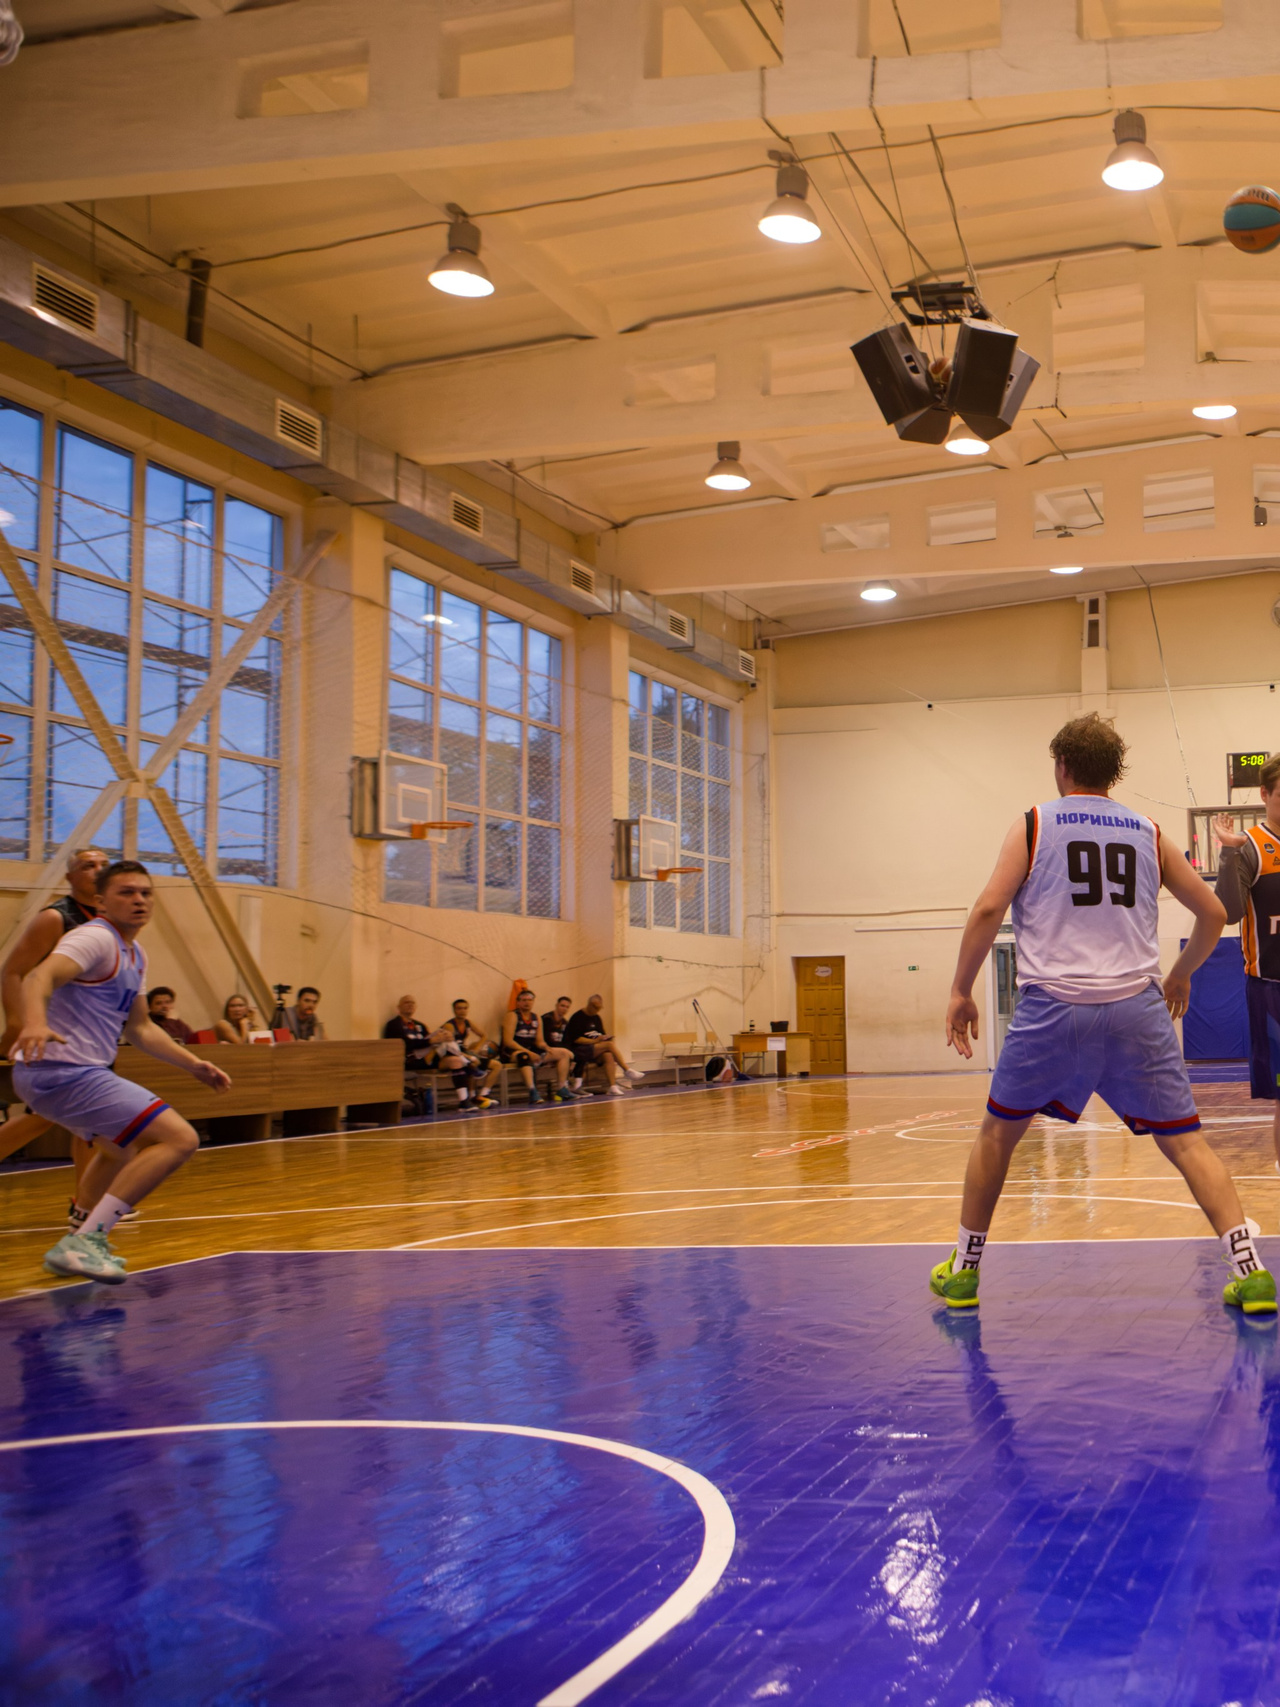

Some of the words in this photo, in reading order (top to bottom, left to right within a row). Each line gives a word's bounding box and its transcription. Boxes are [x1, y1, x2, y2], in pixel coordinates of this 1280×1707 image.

[1240, 754, 1264, 766] 5:08
[1056, 812, 1141, 831] НОРИЦЫН
[1066, 840, 1137, 908] 99
